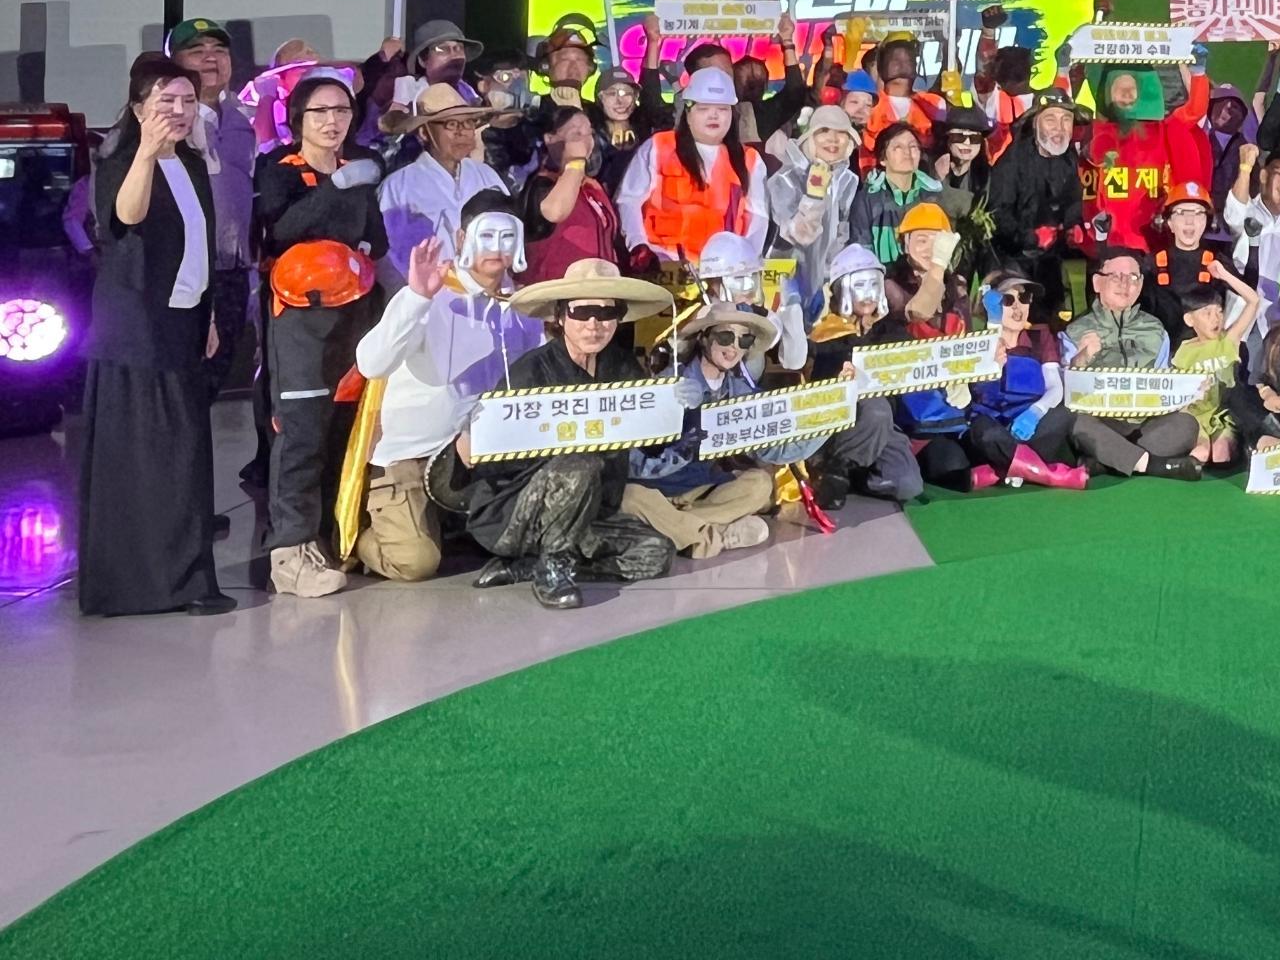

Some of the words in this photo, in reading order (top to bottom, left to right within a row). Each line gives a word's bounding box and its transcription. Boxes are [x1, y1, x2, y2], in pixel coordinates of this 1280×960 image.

[663, 19, 699, 31] 농기계
[939, 339, 991, 358] 농업인의
[1093, 376, 1131, 391] 농작업
[502, 401, 543, 421] 가장
[551, 396, 590, 417] 멋진
[599, 391, 656, 413] 패션은
[716, 406, 758, 427] 태우지
